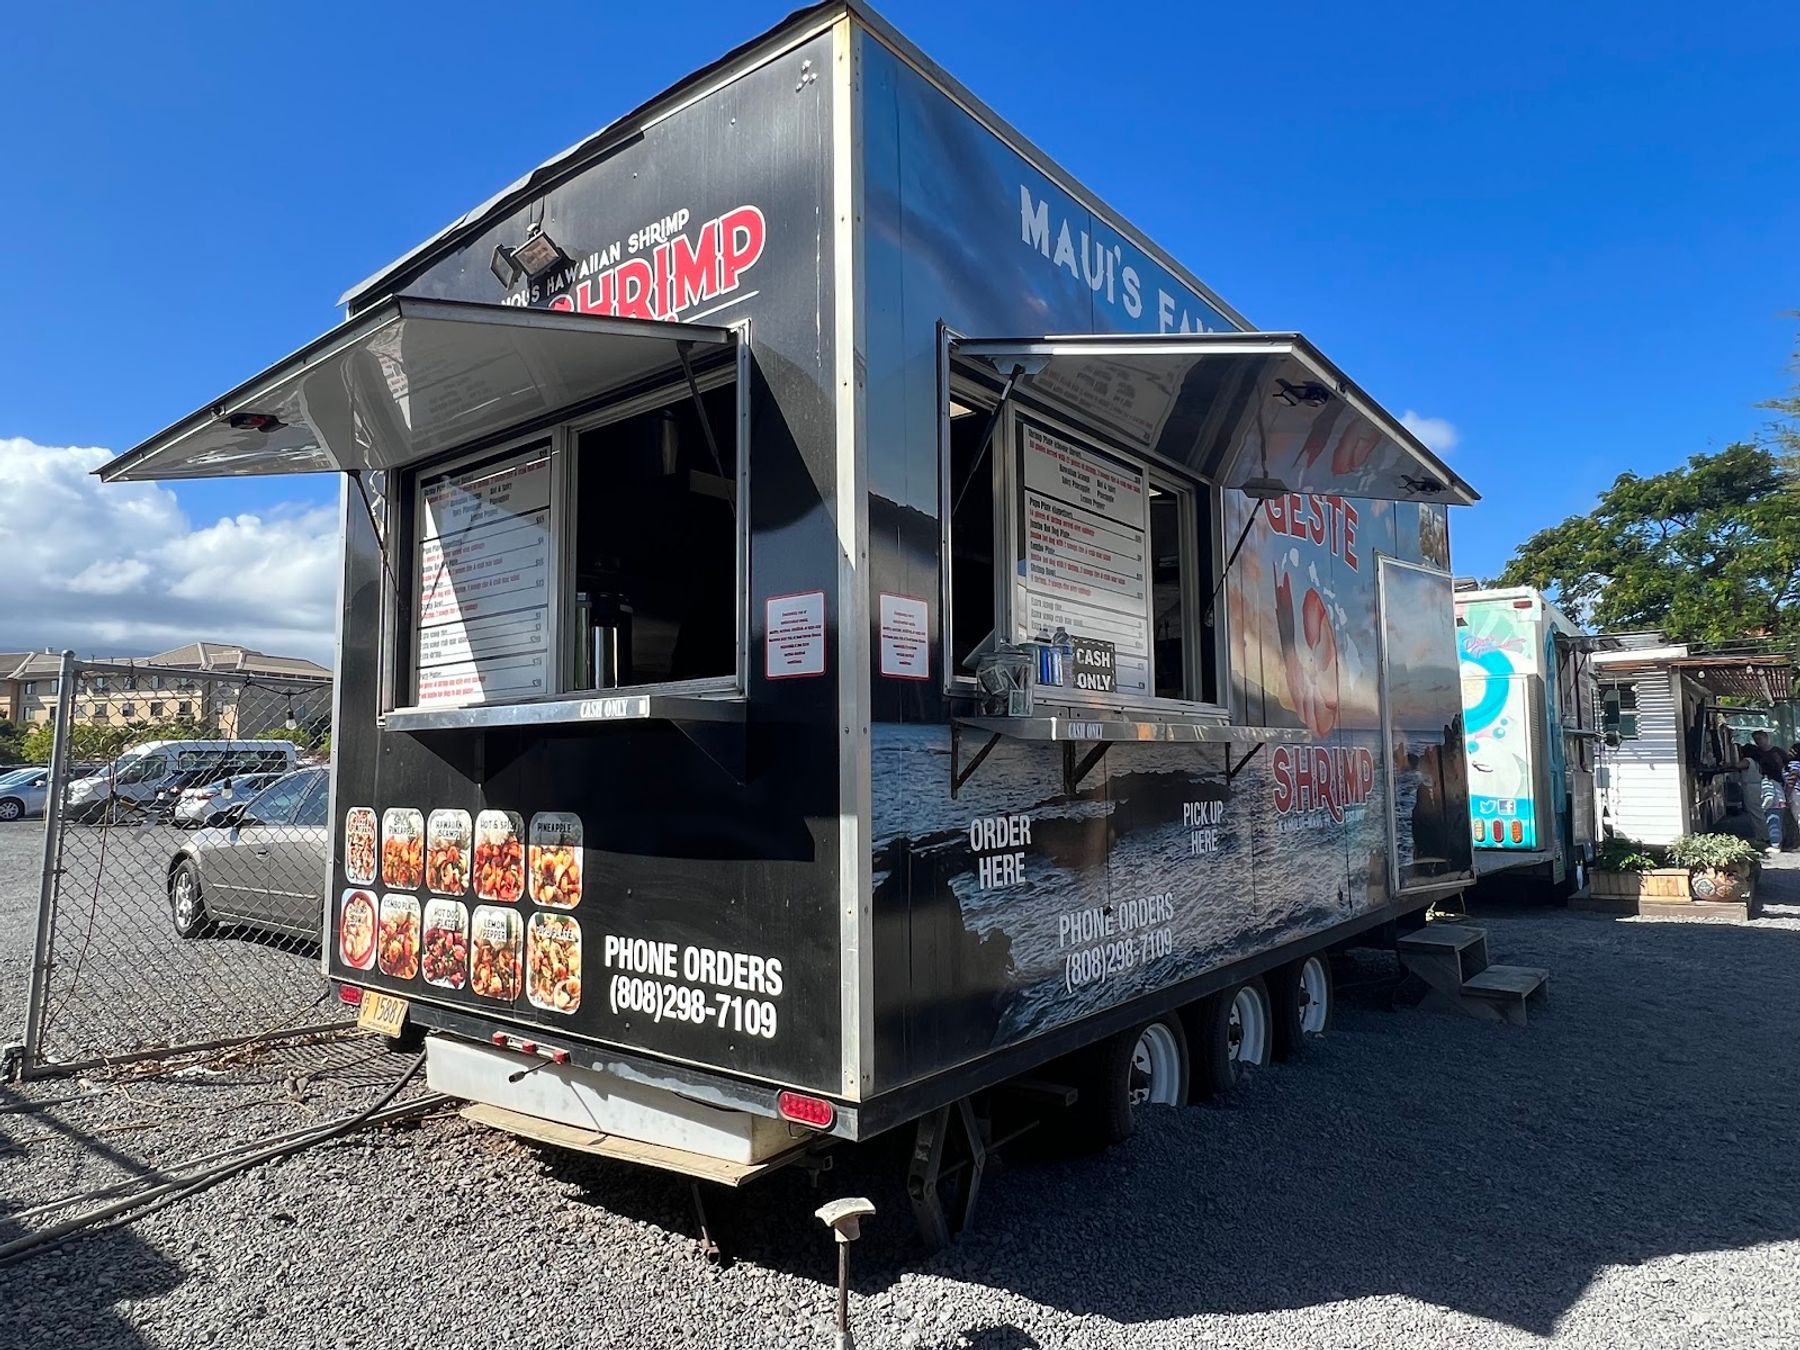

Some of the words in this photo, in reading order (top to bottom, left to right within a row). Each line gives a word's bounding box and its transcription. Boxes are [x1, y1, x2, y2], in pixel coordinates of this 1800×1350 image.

[547, 241, 620, 296] HAWAIIAN
[627, 208, 690, 254] SHRIMP
[548, 205, 766, 321] HRIMP
[1020, 184, 1142, 319] MAUI'S
[1263, 494, 1359, 574] GESTE
[1076, 648, 1111, 668] CASH
[1077, 672, 1111, 691] ONLY
[580, 701, 602, 718] CASH
[604, 699, 628, 717] ONLY
[1068, 722, 1086, 739] CASH
[1086, 723, 1104, 739] ONLY
[1273, 746, 1374, 824] SHRIMP
[537, 822, 573, 833] PINEAPPLE
[1183, 801, 1208, 827] PICK
[1209, 800, 1224, 825] UP
[970, 815, 1032, 851] ORDER
[1191, 829, 1218, 856] HERE
[979, 852, 1026, 890] HERE
[383, 900, 402, 910] COMBO
[1058, 910, 1114, 948] PHONE
[1118, 892, 1174, 931] ORDERS
[481, 929, 506, 940] PEPPER
[483, 919, 506, 930] LEMON
[605, 935, 678, 978] PHONE
[683, 946, 783, 996] ORDERS
[1065, 927, 1173, 994] (808)298-7109
[609, 974, 777, 1039] (808)298-7109
